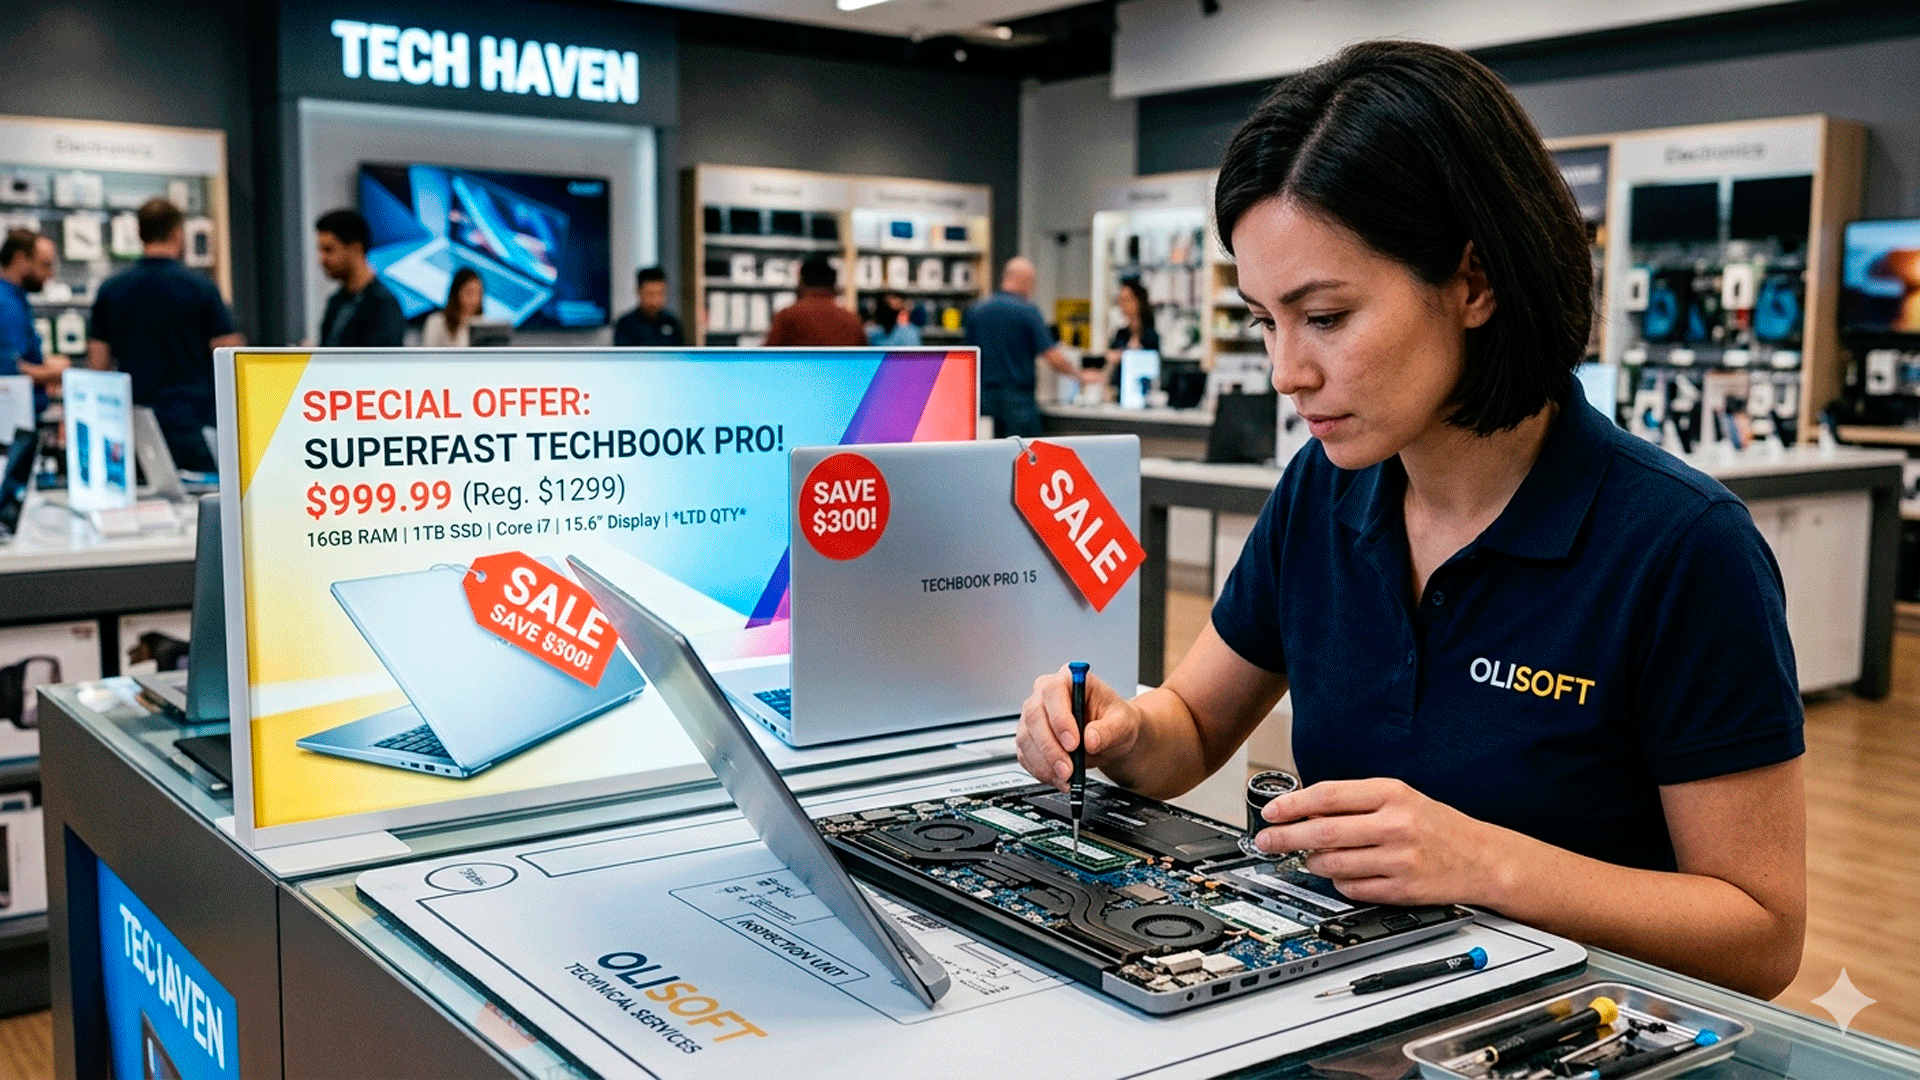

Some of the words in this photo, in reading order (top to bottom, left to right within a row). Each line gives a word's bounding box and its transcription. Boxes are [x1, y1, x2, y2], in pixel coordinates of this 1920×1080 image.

[331, 19, 470, 88] TECH
[480, 35, 639, 104] HAVEN
[303, 389, 462, 422] SPECIAL
[473, 387, 590, 418] OFFER:
[304, 433, 517, 469] SUPERFAST
[526, 427, 706, 461] TECHBOOK
[715, 424, 783, 454] PRO!
[306, 481, 452, 520] $999.99
[463, 480, 528, 513] (Reg.
[538, 474, 625, 505] $1299)
[813, 478, 876, 504] SAVE
[307, 530, 353, 547] 16GB
[358, 527, 398, 544] RAM
[413, 525, 445, 541] 1TB
[450, 523, 482, 539] SSD
[496, 521, 533, 536] Core
[537, 519, 550, 533] i7
[608, 512, 660, 531] Display
[813, 507, 877, 535] $300!
[1039, 469, 1128, 584] SALE
[921, 575, 990, 592] TECHBOOK
[994, 573, 1019, 587] PRO
[1023, 570, 1037, 583] 15
[503, 567, 610, 649] SALE
[490, 604, 542, 643] SAVE
[542, 631, 593, 671] $300!
[1469, 657, 1596, 705] OLISOFT
[597, 951, 769, 1042] OLISOFT
[630, 1008, 703, 1054] SERVICES
